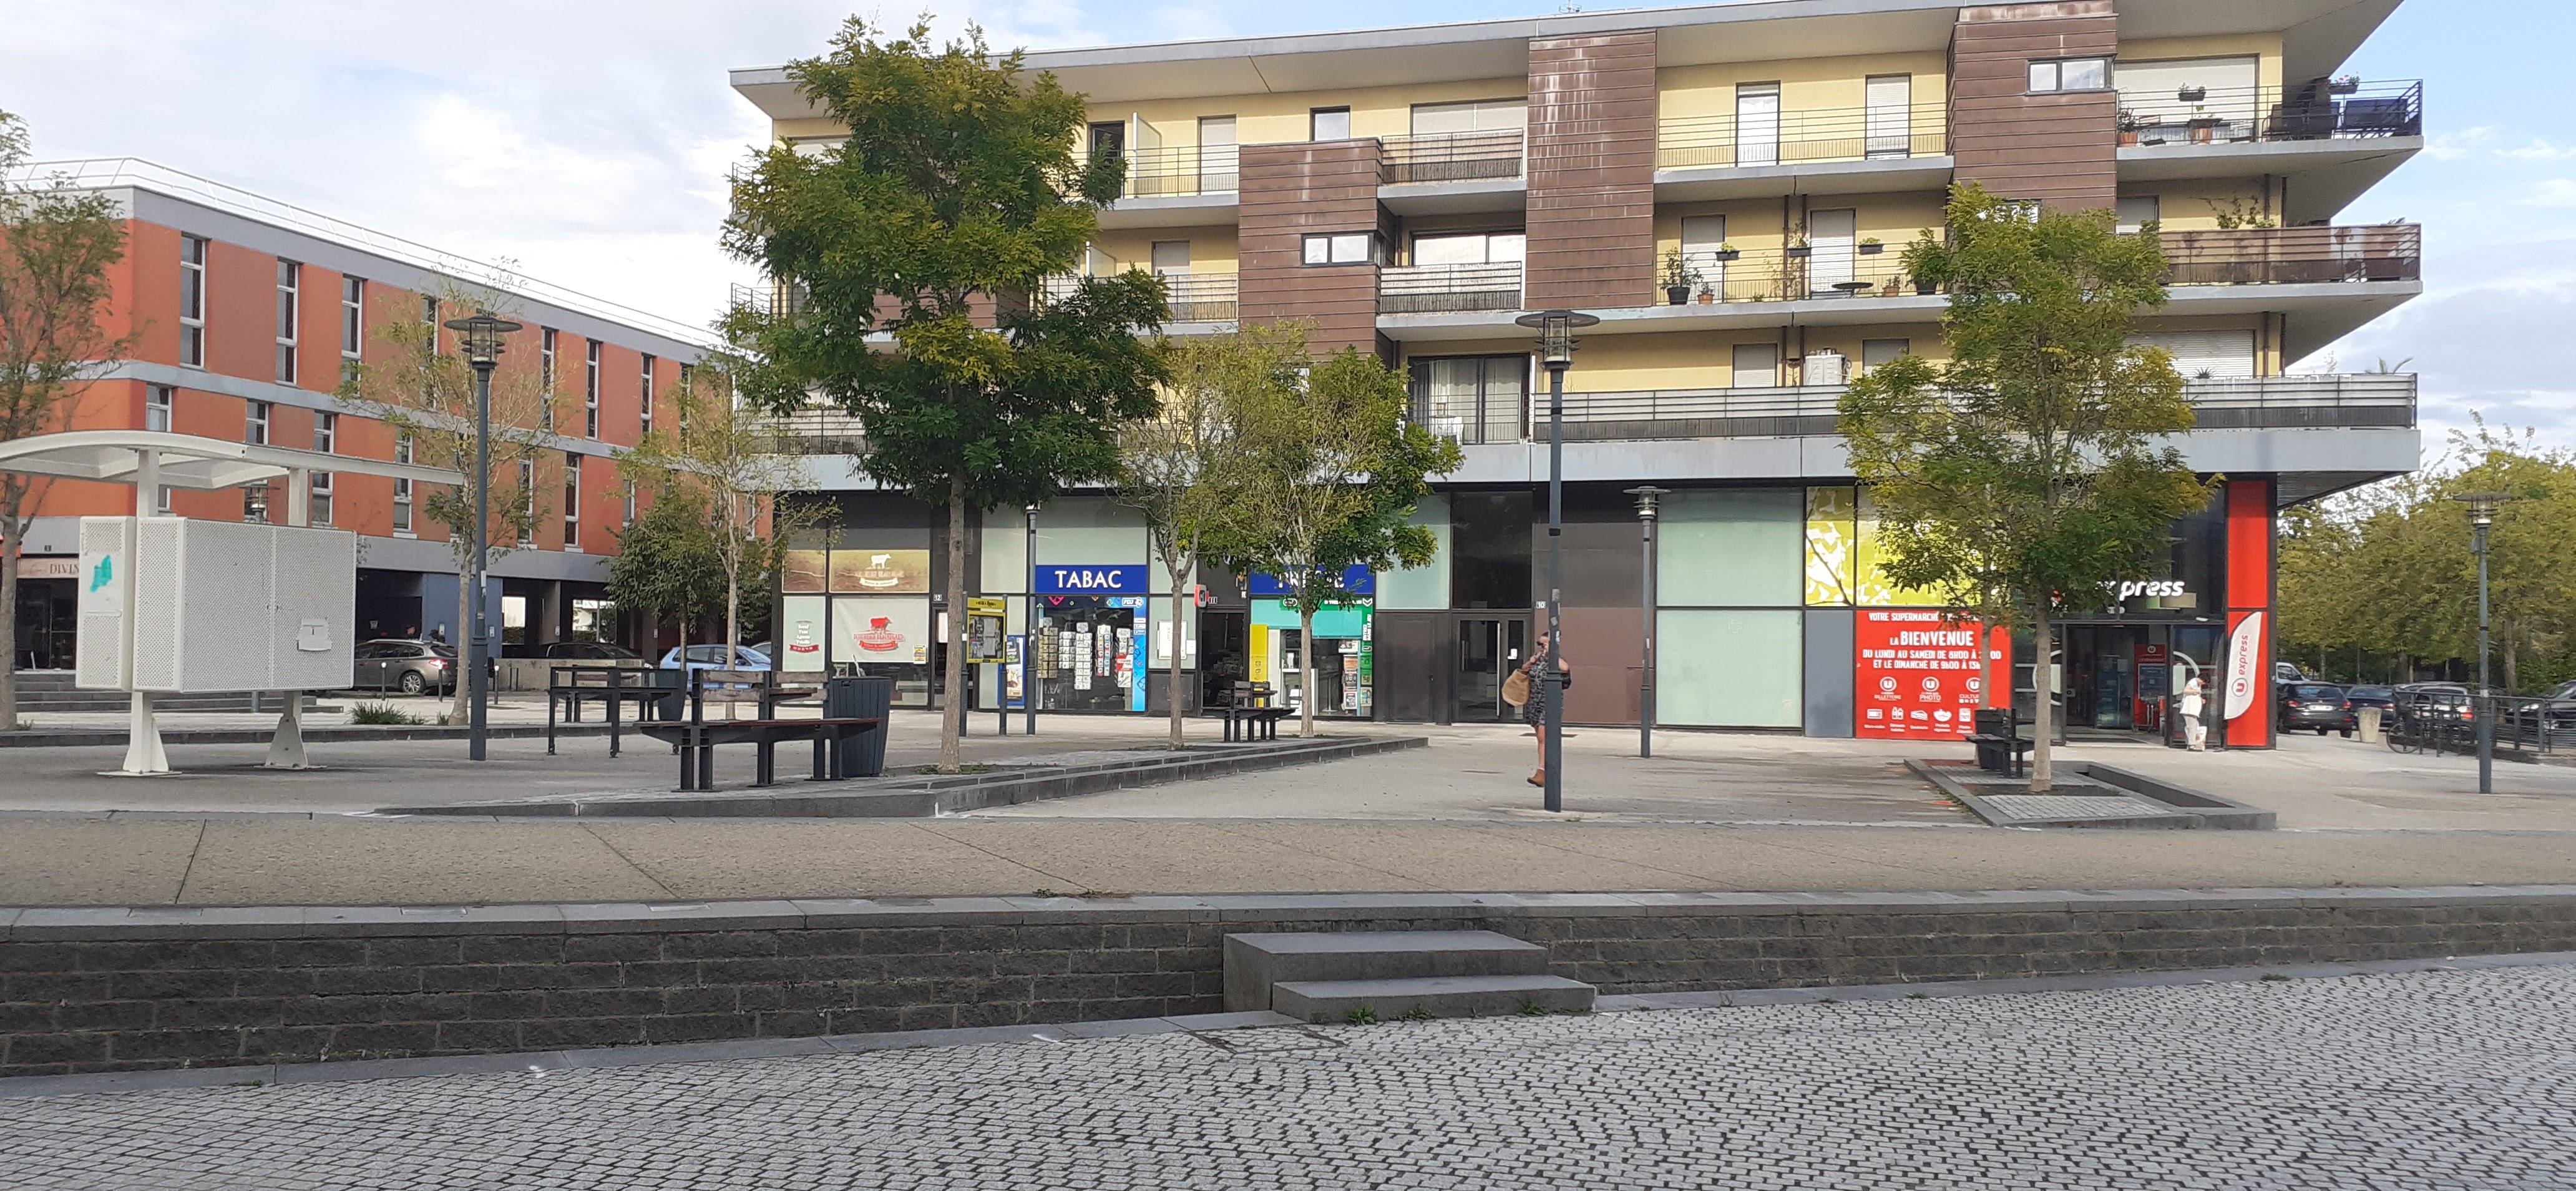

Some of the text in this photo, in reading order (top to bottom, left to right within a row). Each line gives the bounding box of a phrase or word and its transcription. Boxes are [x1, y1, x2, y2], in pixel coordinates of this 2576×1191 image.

[1055, 571, 1121, 588] TABAC
[1869, 612, 1889, 621] VOTRE
[1891, 611, 1939, 622] SUPERMARCHÉ
[1890, 631, 1974, 646] LA BIENVENUE
[1863, 649, 1873, 658] DU
[1875, 650, 1895, 659] LUNDI
[1897, 650, 1908, 659] AU
[1910, 650, 1935, 659] SAMEDI
[1937, 650, 1946, 659] DE
[1971, 649, 1977, 659] À
[2238, 635, 2248, 675] express
[1873, 660, 1882, 669] ET
[1884, 660, 1892, 669] LE
[1894, 660, 1928, 669] DIMANCHE
[1930, 660, 1939, 669] DE
[1962, 659, 1968, 670] À
[1883, 680, 1893, 689] U
[1925, 680, 1935, 689] U
